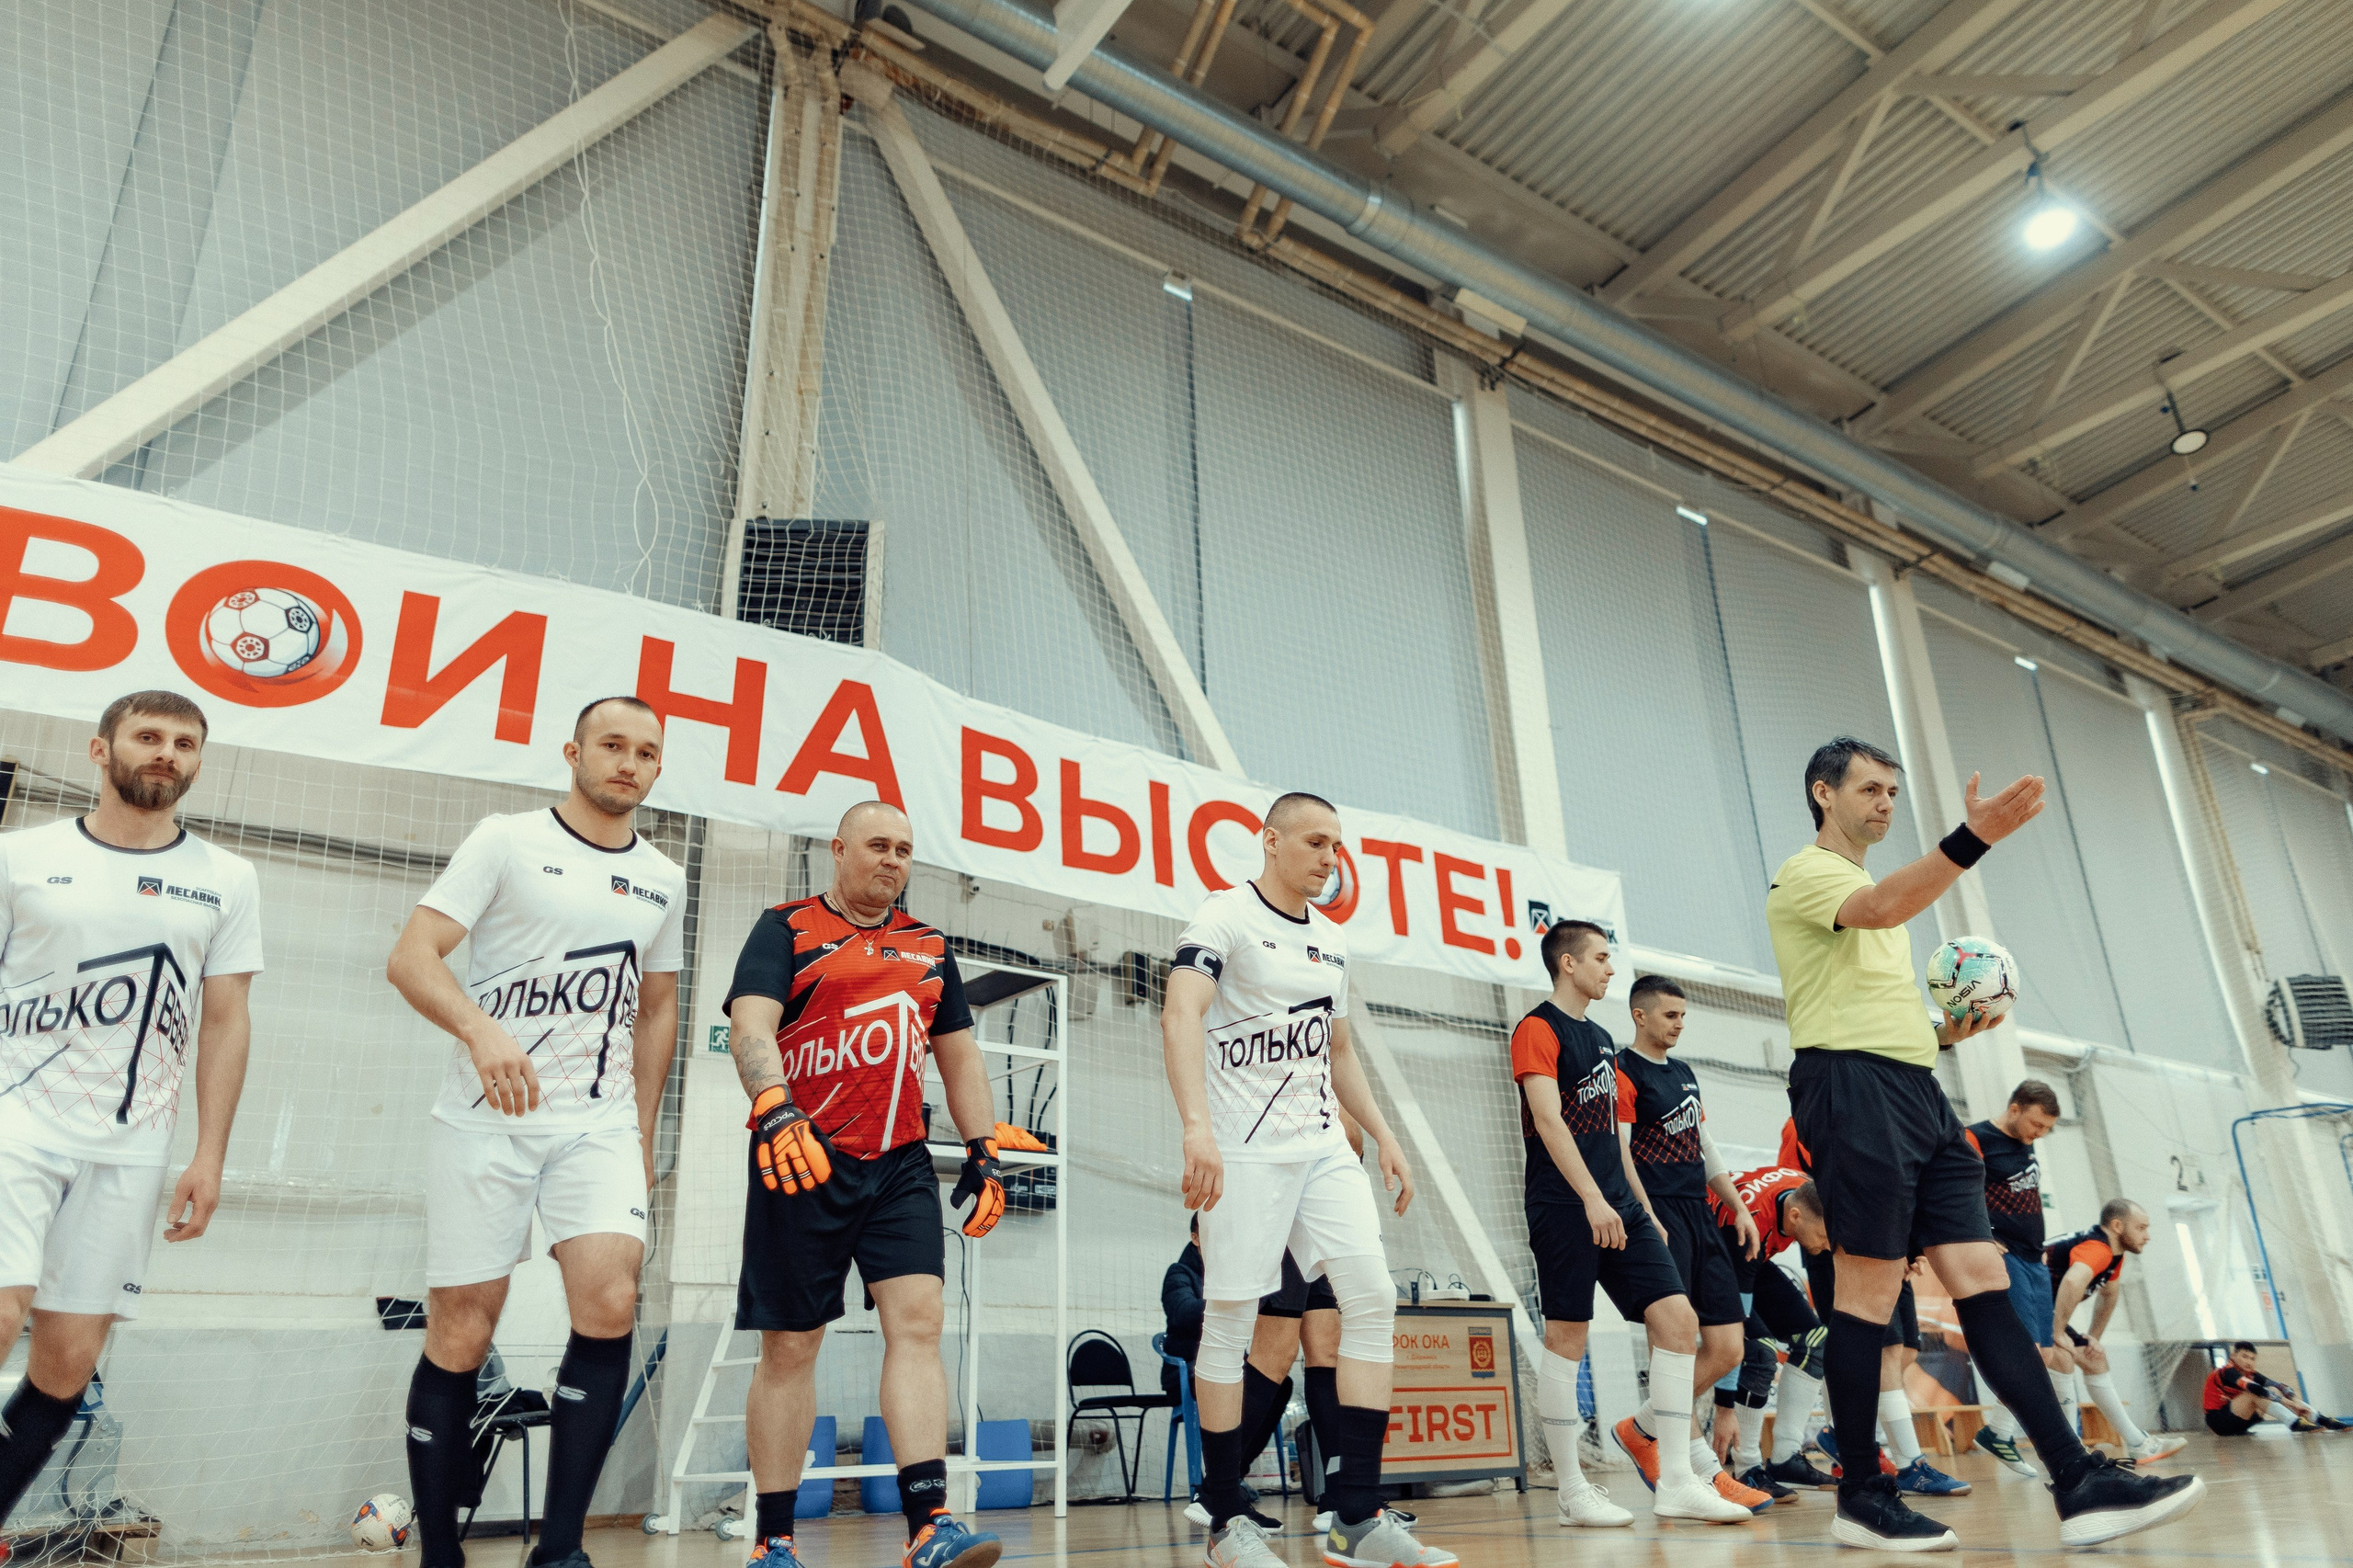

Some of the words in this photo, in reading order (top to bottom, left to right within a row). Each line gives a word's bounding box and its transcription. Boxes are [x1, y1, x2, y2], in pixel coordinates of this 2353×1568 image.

[634, 634, 908, 817] НА
[47, 876, 73, 884] GS
[543, 865, 563, 876] GS
[165, 884, 222, 907] ЛЕСАВИК
[1262, 940, 1277, 949] GS
[1194, 949, 1217, 974] C
[1946, 979, 1983, 1009] VISION
[1219, 1016, 1324, 1071] ТОЛЬКО
[630, 1207, 645, 1220] GS
[122, 1282, 142, 1295] GS
[1422, 1334, 1450, 1349] ОКА
[1383, 1403, 1497, 1444] FIRST
